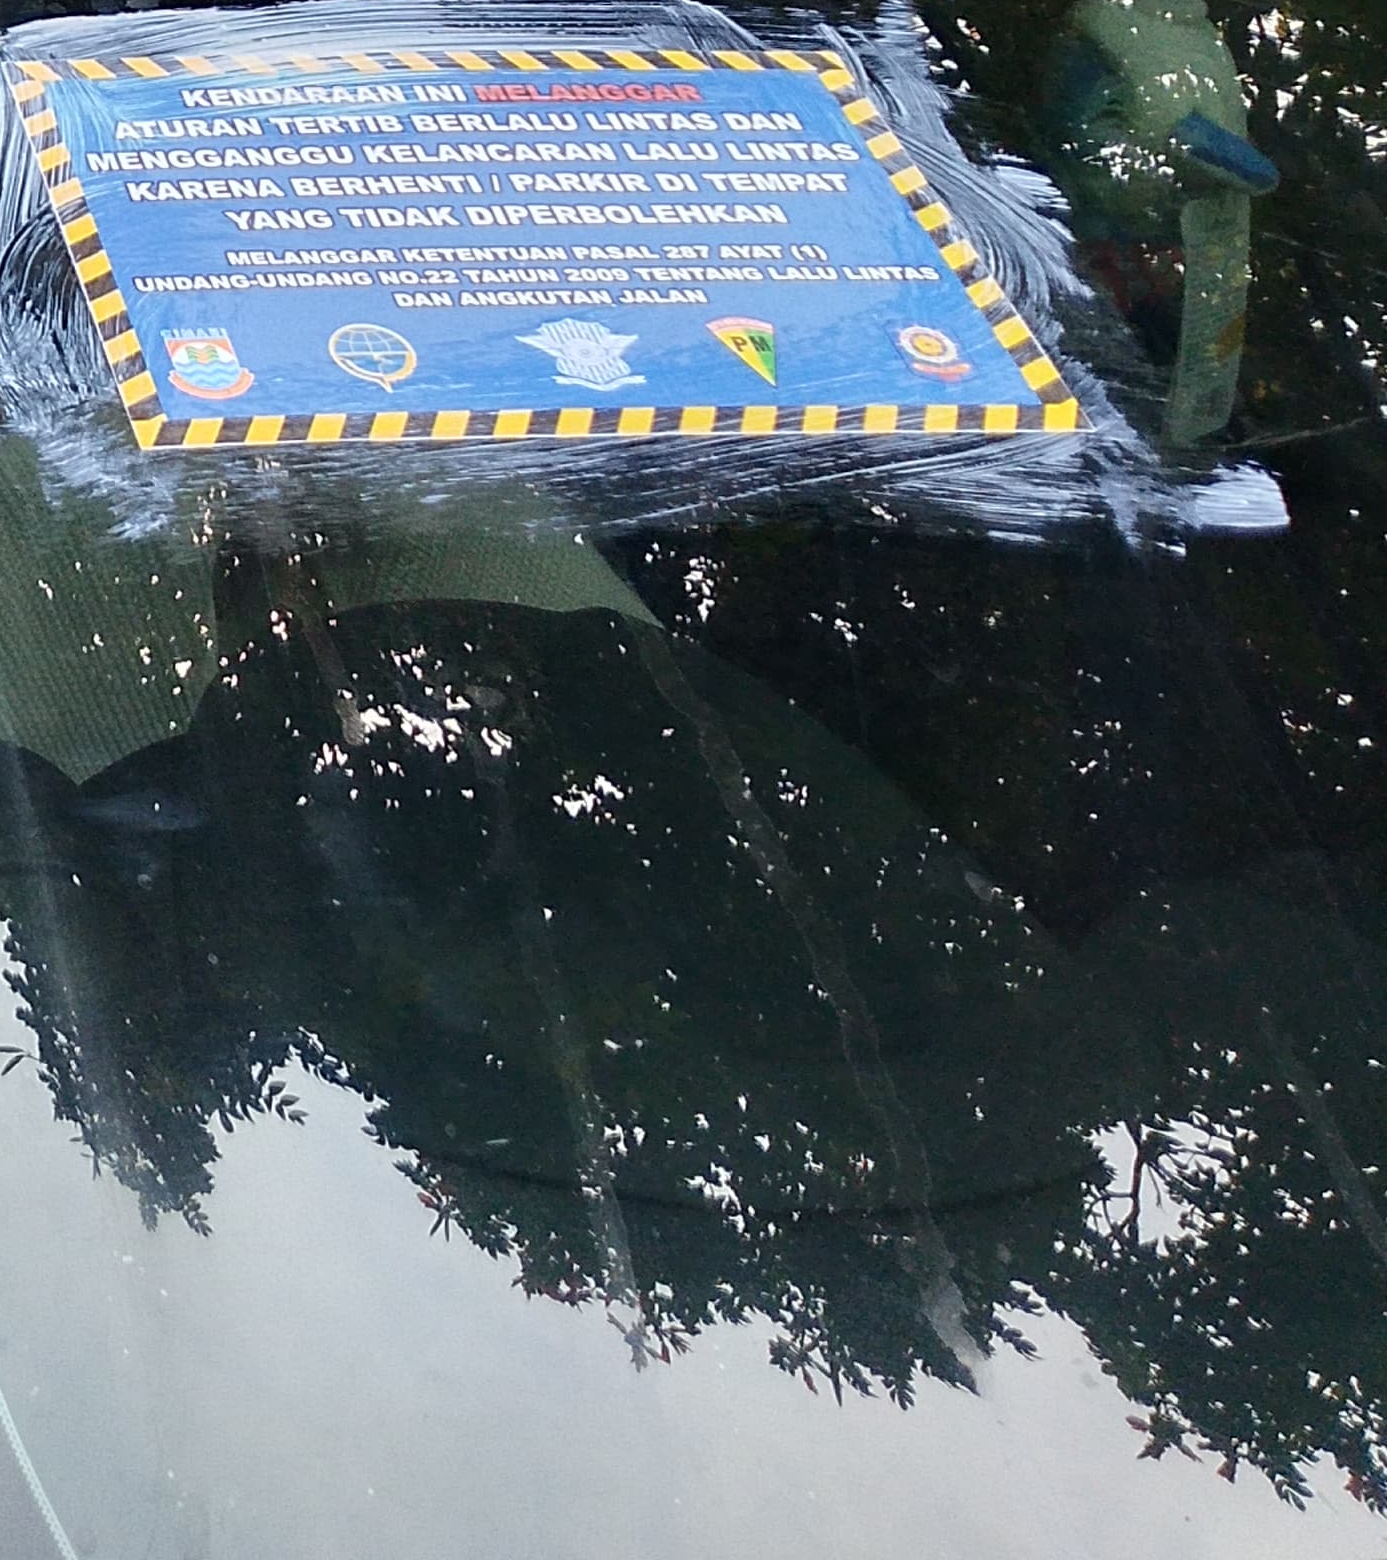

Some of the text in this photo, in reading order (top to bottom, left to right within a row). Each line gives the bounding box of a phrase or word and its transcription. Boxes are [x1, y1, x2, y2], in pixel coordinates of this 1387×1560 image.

[181, 83, 702, 109] KENDARAAN INI MELANGGAR
[115, 112, 804, 141] ATURAN TERTIB BERLALU LINTAS DAN
[86, 142, 860, 172] MENGGANGGU KELANCARAN LALU LINTAS
[127, 178, 285, 202] KARENA
[289, 174, 483, 197] BERHENTI
[508, 173, 652, 192] PARKIR
[654, 173, 699, 191] DI
[702, 173, 849, 192] TEMPAT
[225, 204, 788, 231] YANG TIDAK DIPERBOLEHKAN
[225, 244, 829, 267] MELANGGAR KETENTUAN PASAL 287 AYAT (1)
[133, 266, 941, 293] UNDANG-UNDANG NO.22 TAHUN 2009 TENTANG LALU LINTAS
[393, 289, 709, 308] DAN ANGKUTAN JALAN
